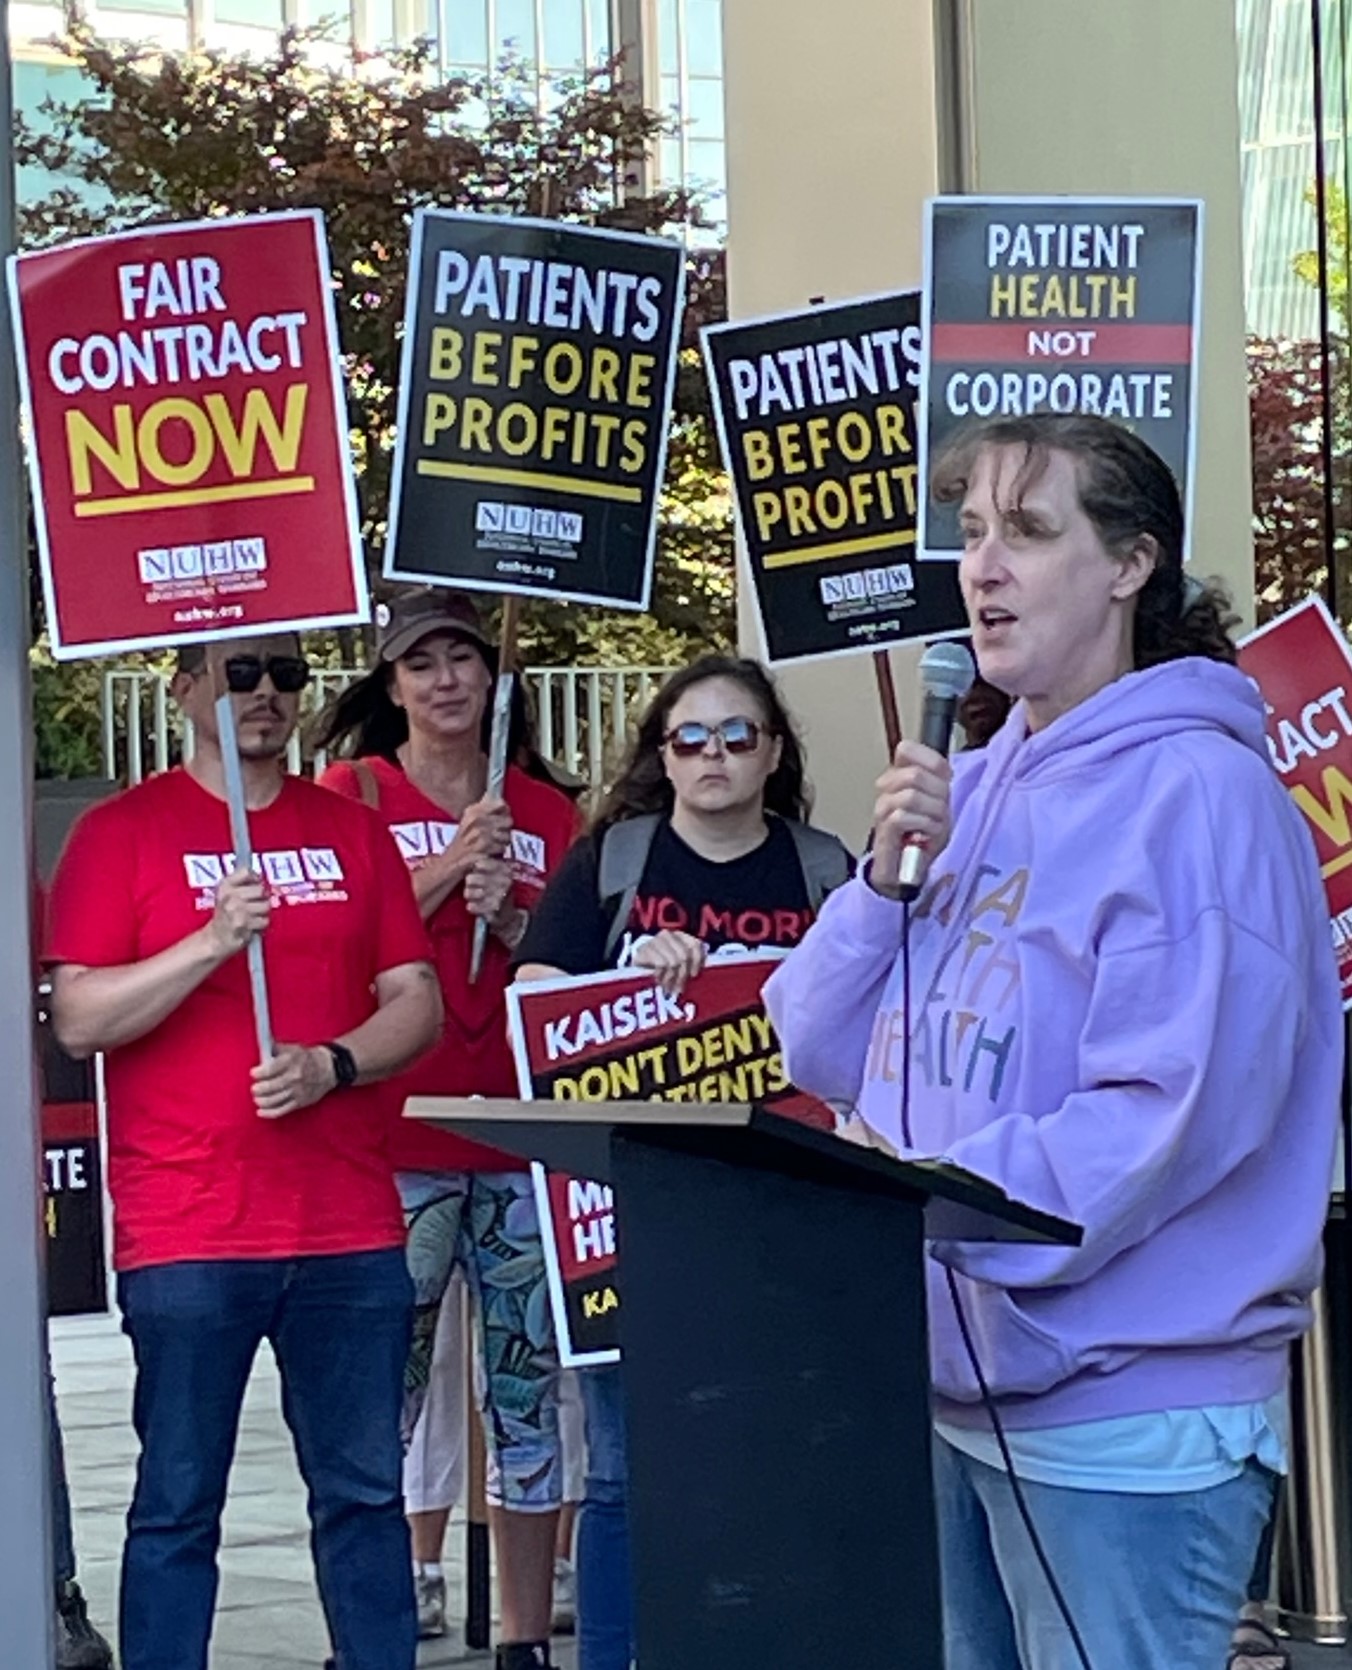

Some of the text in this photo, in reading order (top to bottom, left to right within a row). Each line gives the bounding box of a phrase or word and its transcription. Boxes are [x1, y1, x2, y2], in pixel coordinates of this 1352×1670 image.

[987, 224, 1144, 269] PATIENT
[118, 256, 227, 320] FAIR
[434, 250, 661, 343] PATIENTS
[990, 275, 1137, 318] HEALTH
[49, 312, 307, 395] CONTRACT
[429, 326, 657, 409] BEFORE
[729, 325, 922, 421] PATIENTS
[1027, 331, 1096, 357] NOT
[946, 372, 1173, 418] CORPORATE
[65, 383, 308, 495] NOW
[422, 392, 649, 474] PROFITS
[742, 403, 917, 482] BEFOR
[477, 503, 582, 542] NUHW
[752, 464, 918, 542] PROFIT
[139, 539, 266, 582] NUHW
[821, 565, 913, 604] NUHW
[184, 848, 343, 888] NHW
[634, 896, 810, 942] NO MOR
[553, 1014, 771, 1101] DON'T DENY
